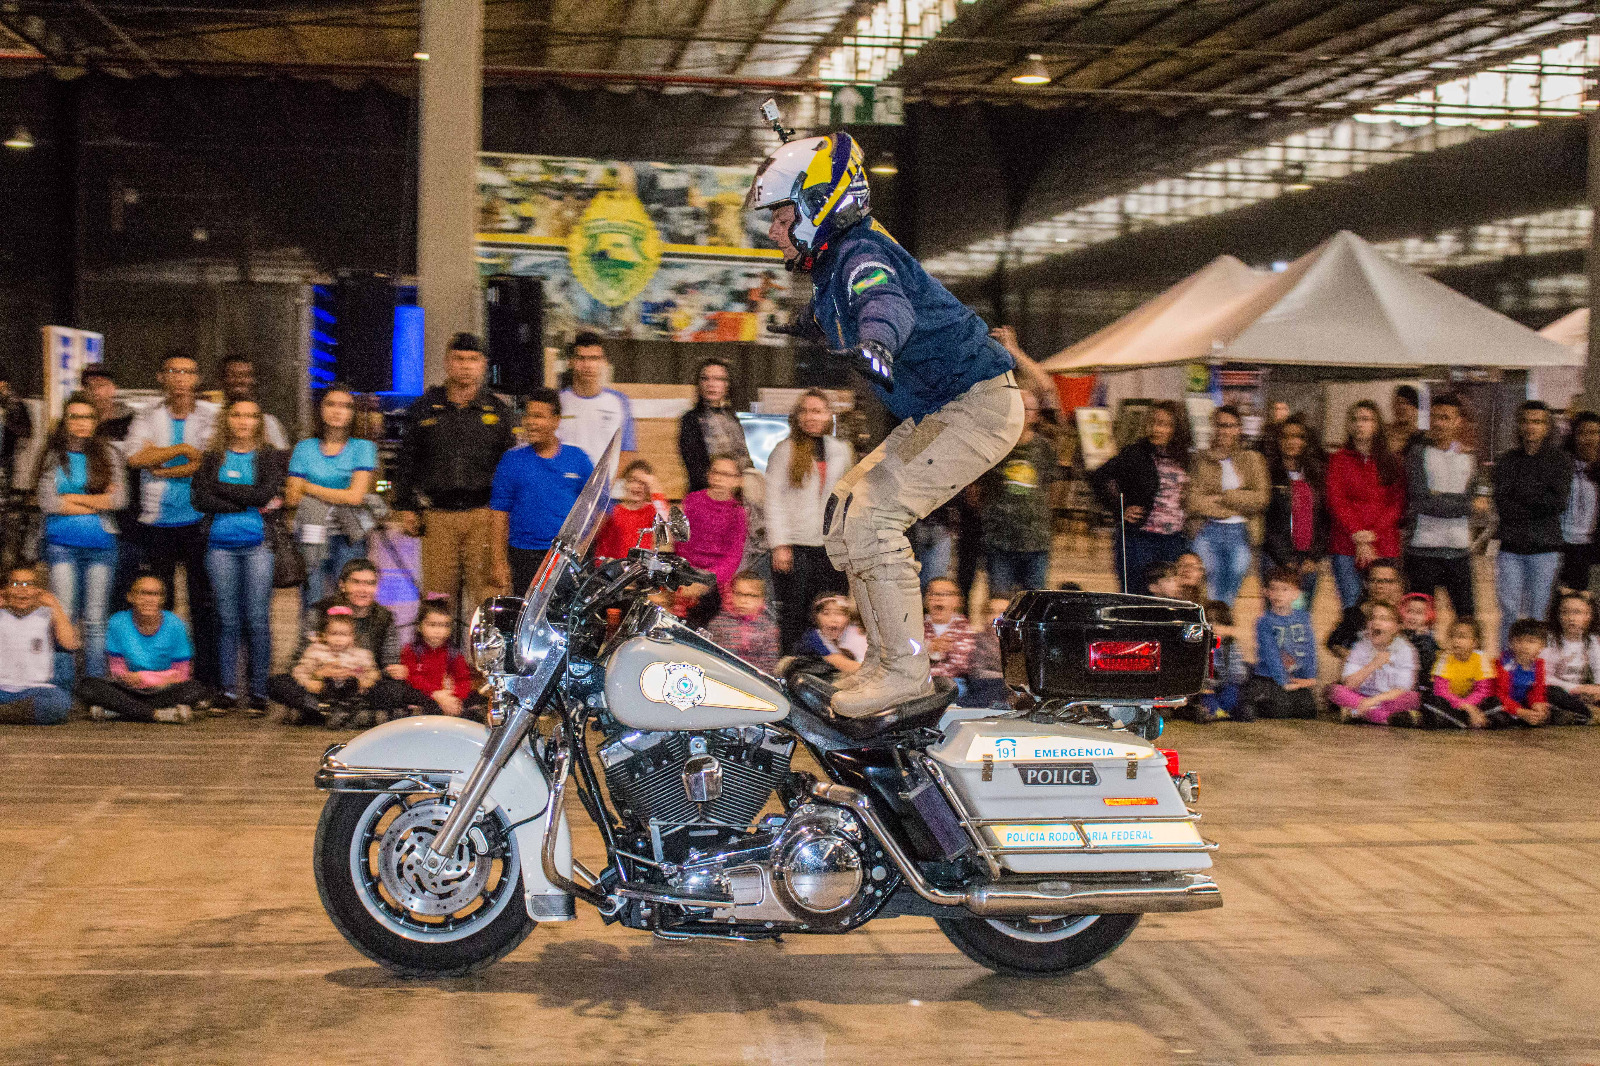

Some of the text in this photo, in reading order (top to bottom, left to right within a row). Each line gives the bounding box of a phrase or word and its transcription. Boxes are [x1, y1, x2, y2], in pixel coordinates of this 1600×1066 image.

[996, 747, 1016, 759] 191
[1027, 769, 1090, 785] POLICE
[1111, 830, 1154, 841] FEDERAL
